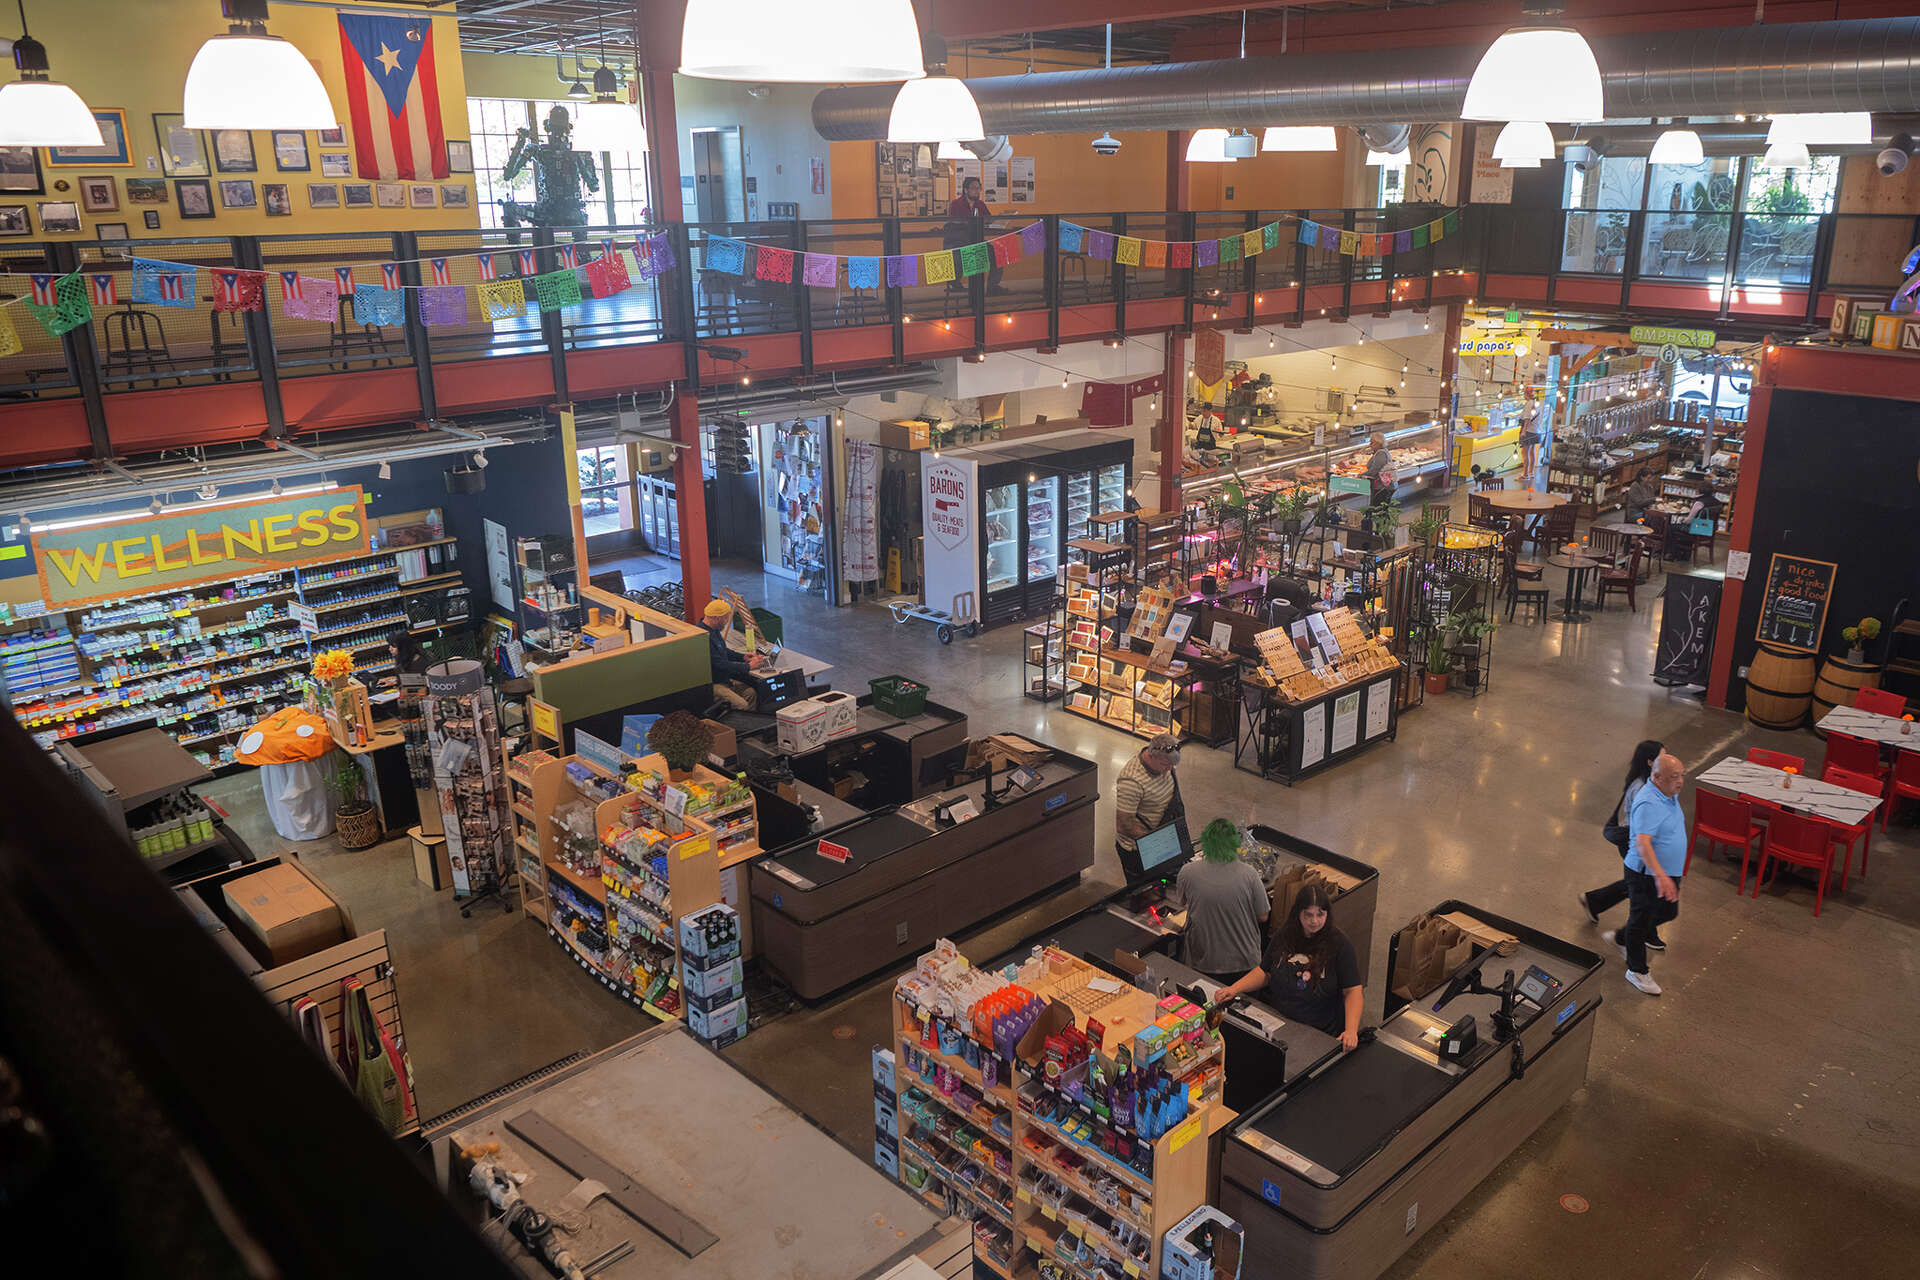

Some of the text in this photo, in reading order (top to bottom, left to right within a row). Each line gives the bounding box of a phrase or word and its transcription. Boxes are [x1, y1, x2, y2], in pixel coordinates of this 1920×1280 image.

[1506, 311, 1519, 322] EXIT
[1476, 341, 1514, 353] papa's
[930, 476, 964, 501] BARONS
[932, 511, 964, 528] QUALITY MEATS
[942, 523, 960, 537] SEAFOOD
[47, 504, 361, 587] WELLNESS
[1788, 564, 1816, 577] nice
[1793, 576, 1826, 590] drinks
[1777, 585, 1827, 600] good food
[1691, 595, 1710, 669] AKEMI
